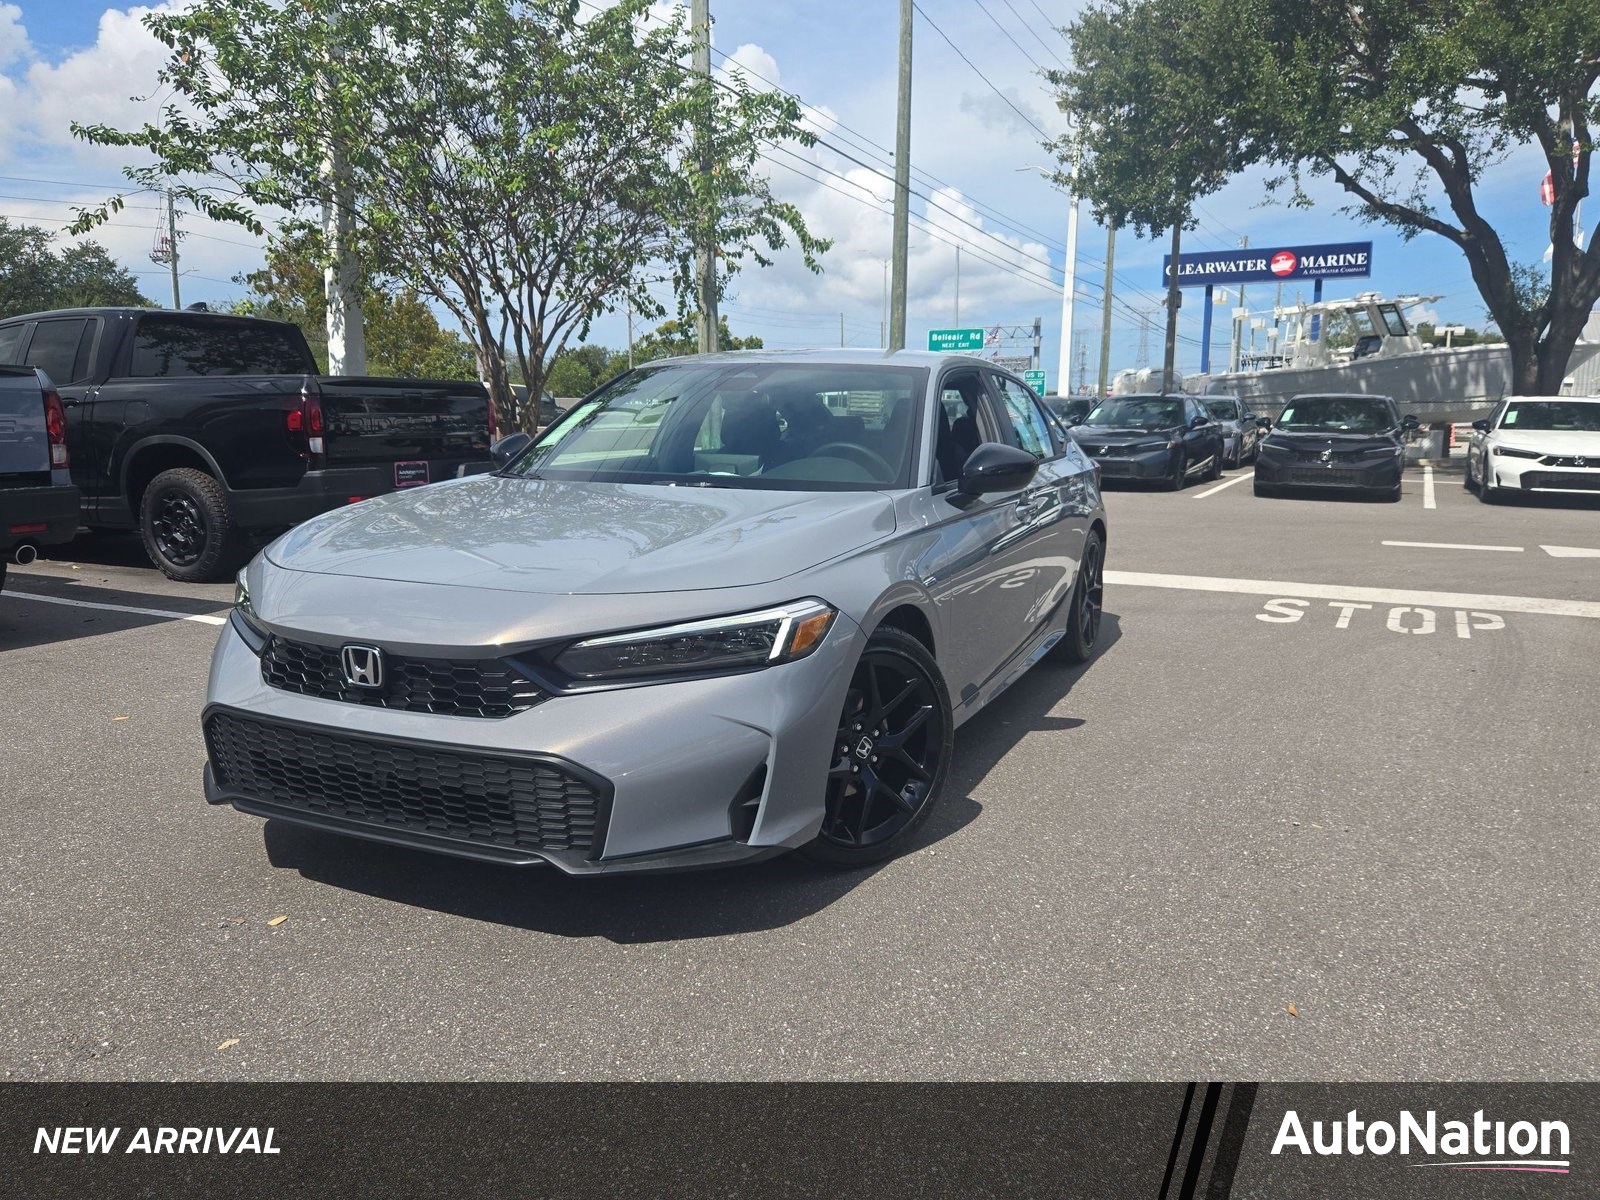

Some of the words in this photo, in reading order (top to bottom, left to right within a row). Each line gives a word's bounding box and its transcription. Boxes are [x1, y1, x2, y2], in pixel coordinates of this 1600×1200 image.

[1300, 252, 1368, 268] MARINE
[932, 333, 963, 341] Belleair
[970, 331, 980, 340] Rd
[1256, 598, 1505, 638] STOP
